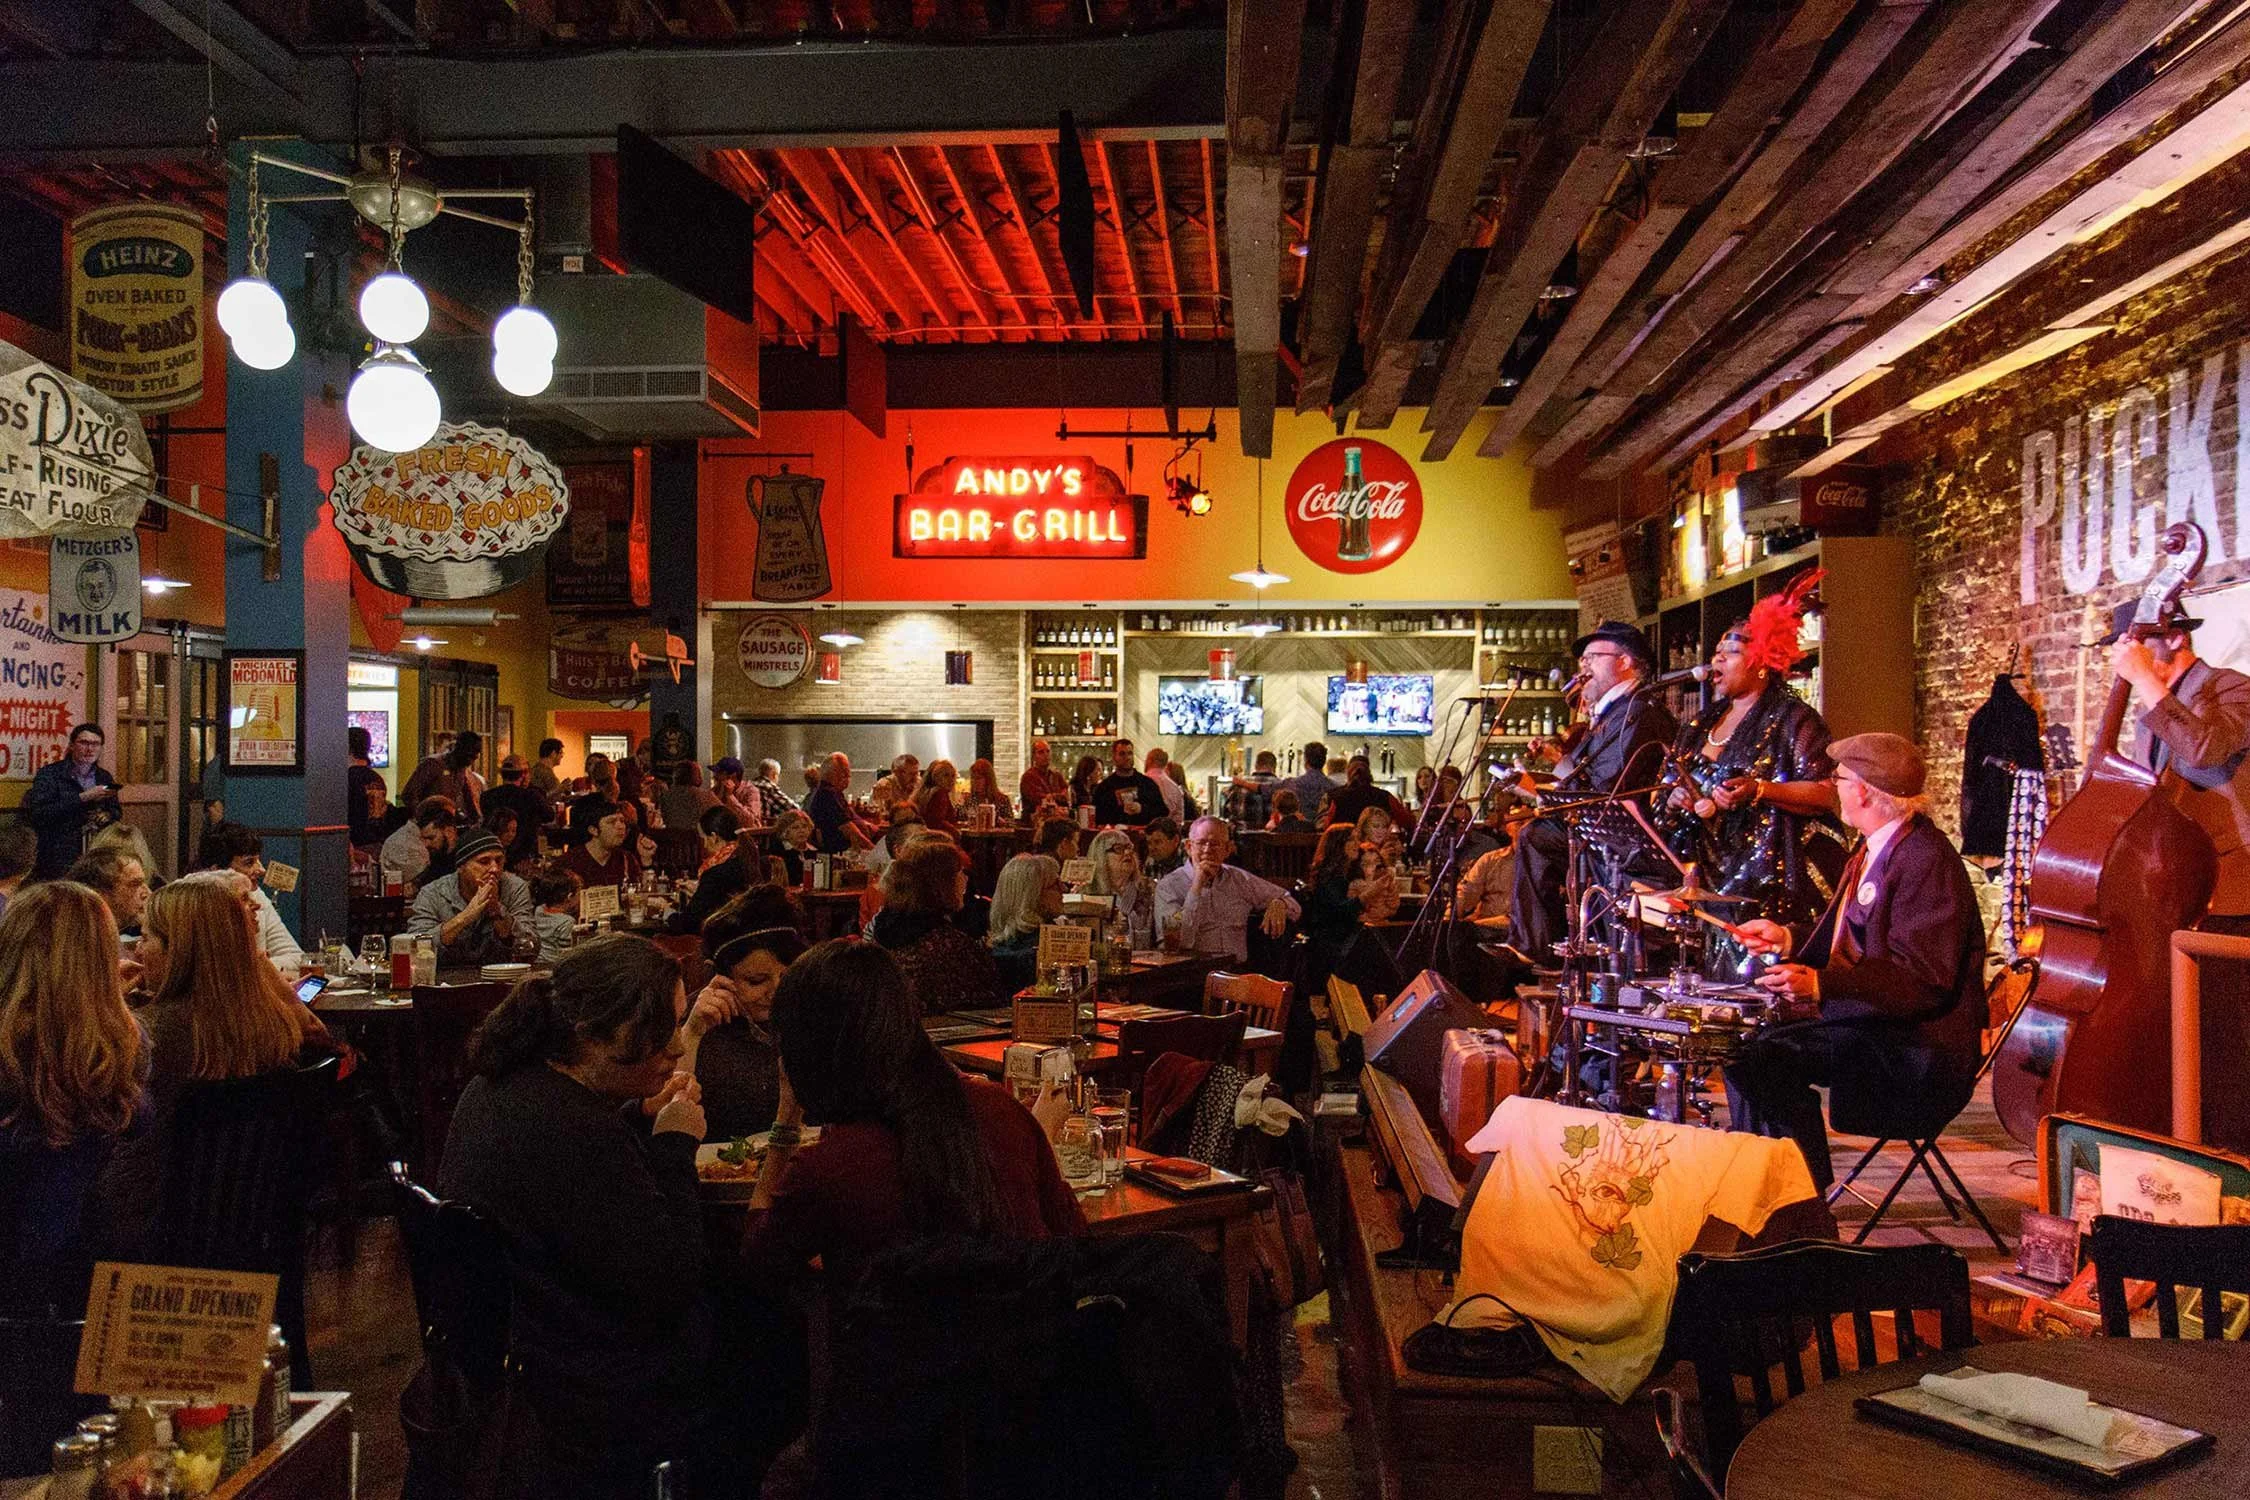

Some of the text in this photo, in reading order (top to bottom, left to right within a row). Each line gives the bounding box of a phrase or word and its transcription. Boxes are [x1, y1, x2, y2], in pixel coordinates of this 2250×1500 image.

[100, 246, 178, 271] HEINZ
[85, 289, 186, 304] OVEN BAKED
[141, 372, 180, 392] STYLE
[25, 372, 130, 466] Dixie
[395, 445, 512, 480] FRESH
[954, 464, 1082, 495] ANDY'S
[49, 490, 114, 526] FLOUR
[361, 484, 553, 532] BAKED GOODS
[1298, 481, 1409, 521] Coca-Cola
[909, 508, 1127, 542] BAR-GRILL
[56, 536, 133, 556] METZGER'S
[760, 563, 820, 582] BREAKFAST
[58, 610, 133, 636] MILK
[763, 628, 781, 637] THE
[13, 641, 30, 651] AND
[741, 641, 804, 655] SAUSAGE
[233, 670, 296, 683] MCDONALD
[240, 662, 289, 670] MICHAEL
[744, 661, 799, 672] MINSTRELS
[131, 1284, 262, 1318] GRAND OPENING!
